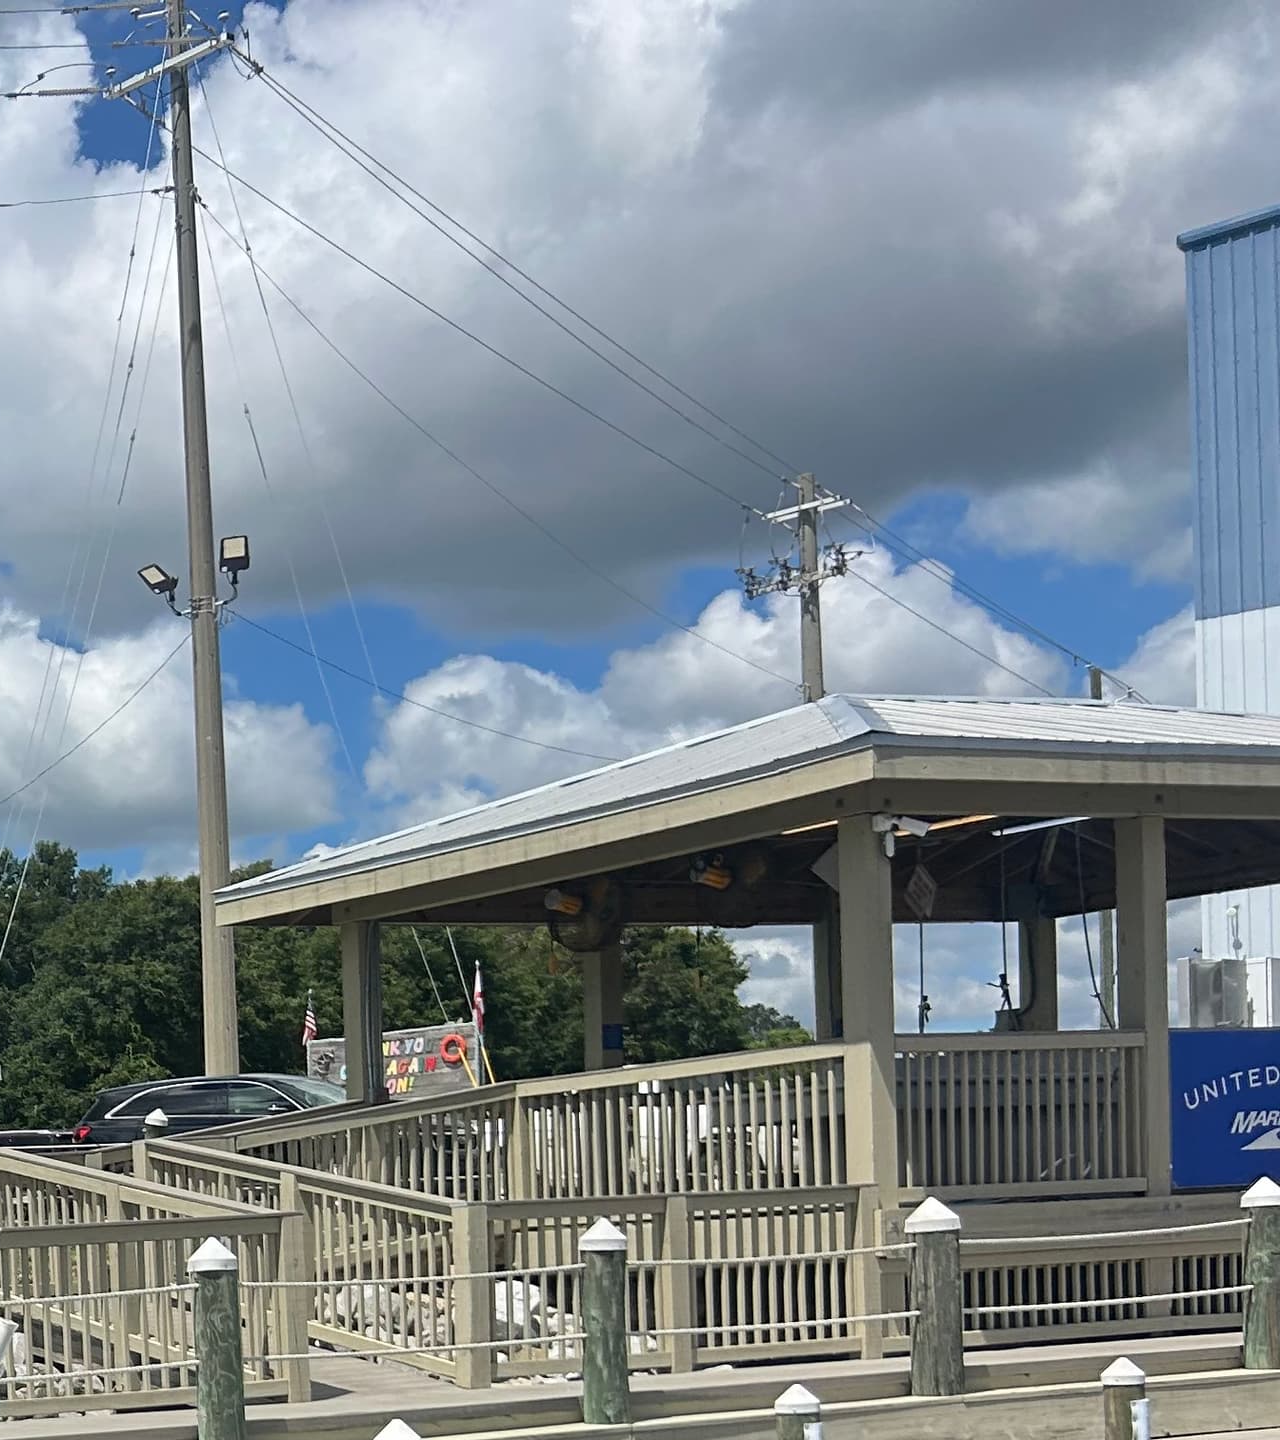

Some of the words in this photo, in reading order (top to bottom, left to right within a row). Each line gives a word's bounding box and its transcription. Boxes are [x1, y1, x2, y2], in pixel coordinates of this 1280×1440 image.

[386, 1056, 438, 1076] AGAIN
[1184, 1065, 1280, 1110] UNITED
[1230, 1110, 1280, 1134] MAR
